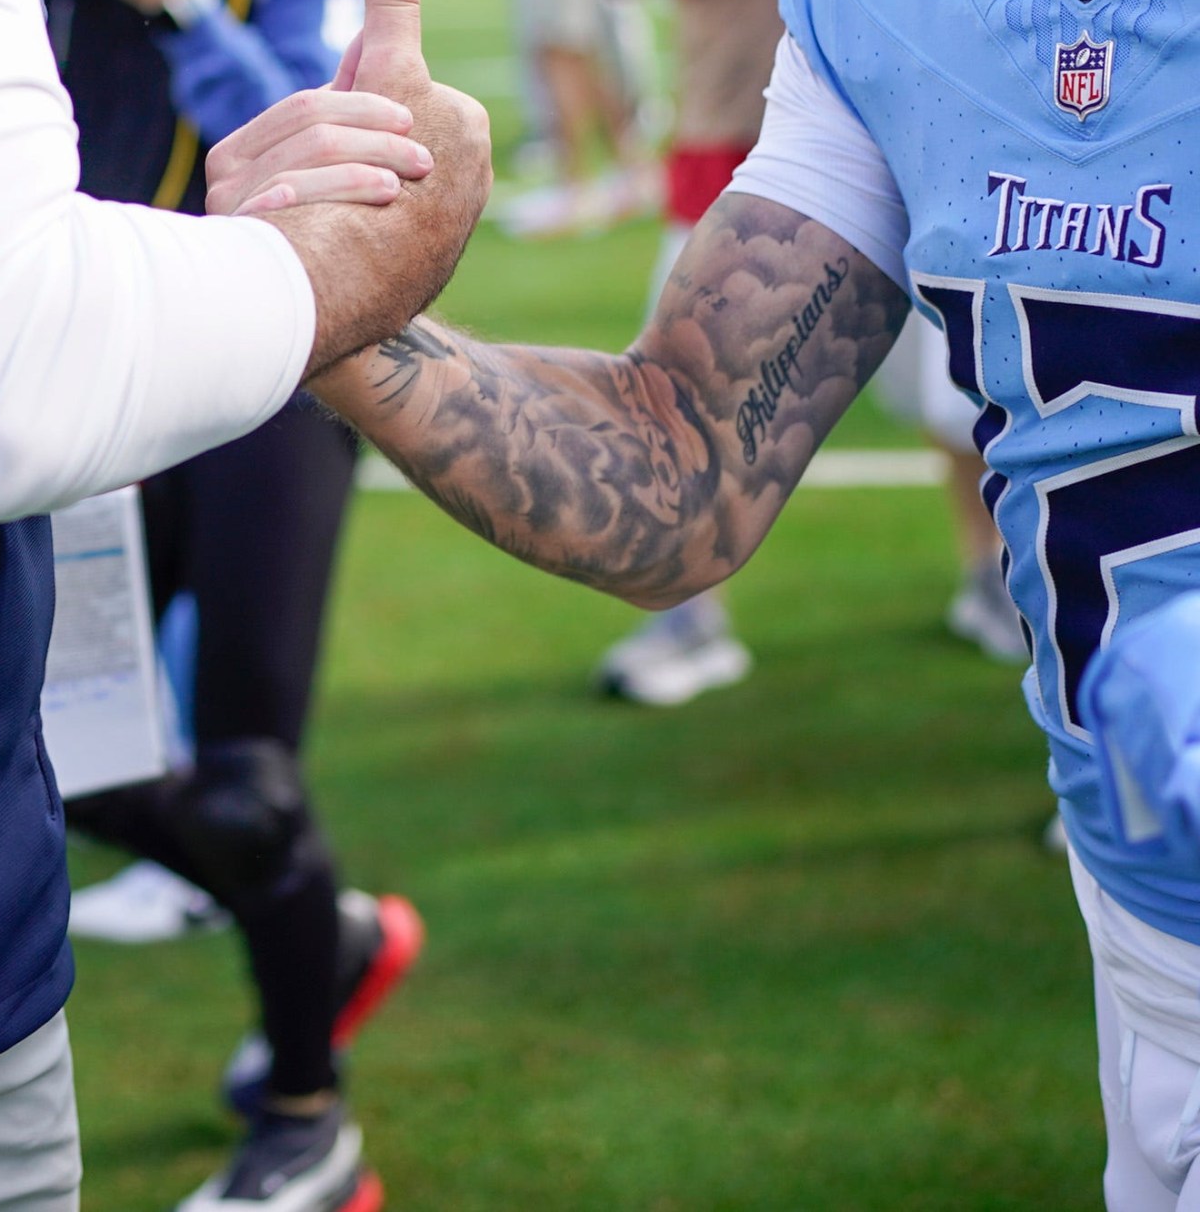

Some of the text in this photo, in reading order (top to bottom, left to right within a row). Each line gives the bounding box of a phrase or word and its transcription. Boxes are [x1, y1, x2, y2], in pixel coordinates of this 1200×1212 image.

[1061, 72, 1100, 106] NFL
[987, 170, 1173, 269] TITANS
[737, 257, 849, 465] Philippians
